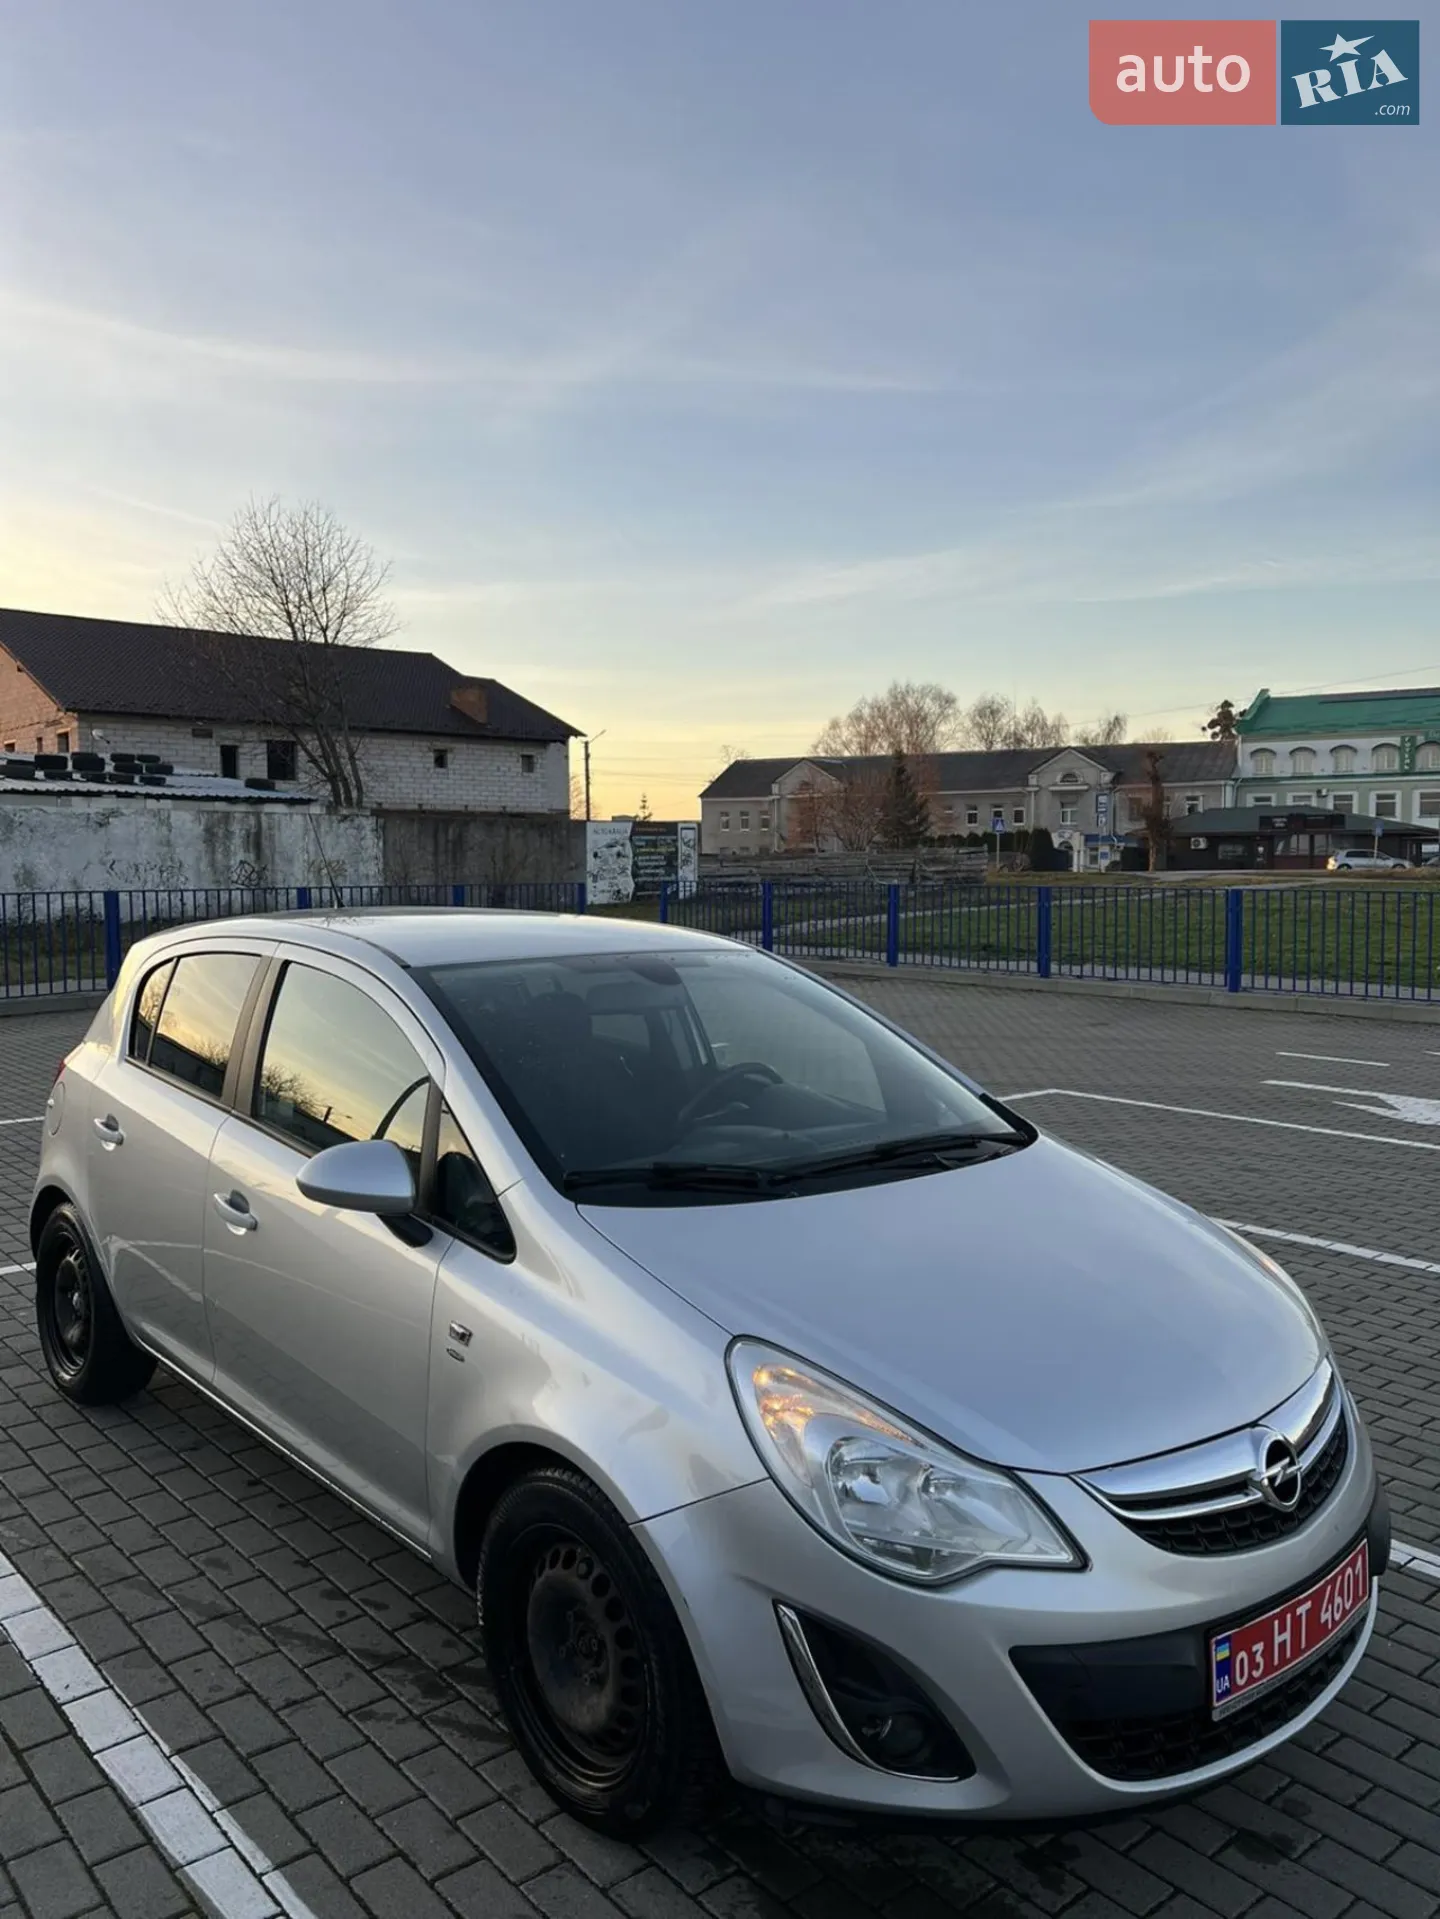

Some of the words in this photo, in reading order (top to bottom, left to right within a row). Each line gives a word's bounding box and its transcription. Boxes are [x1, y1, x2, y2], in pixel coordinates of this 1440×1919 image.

[1235, 1641, 1265, 1686] 03
[1273, 1600, 1312, 1666] HT
[1320, 1554, 1364, 1630] 4601
[1216, 1674, 1231, 1694] UA
